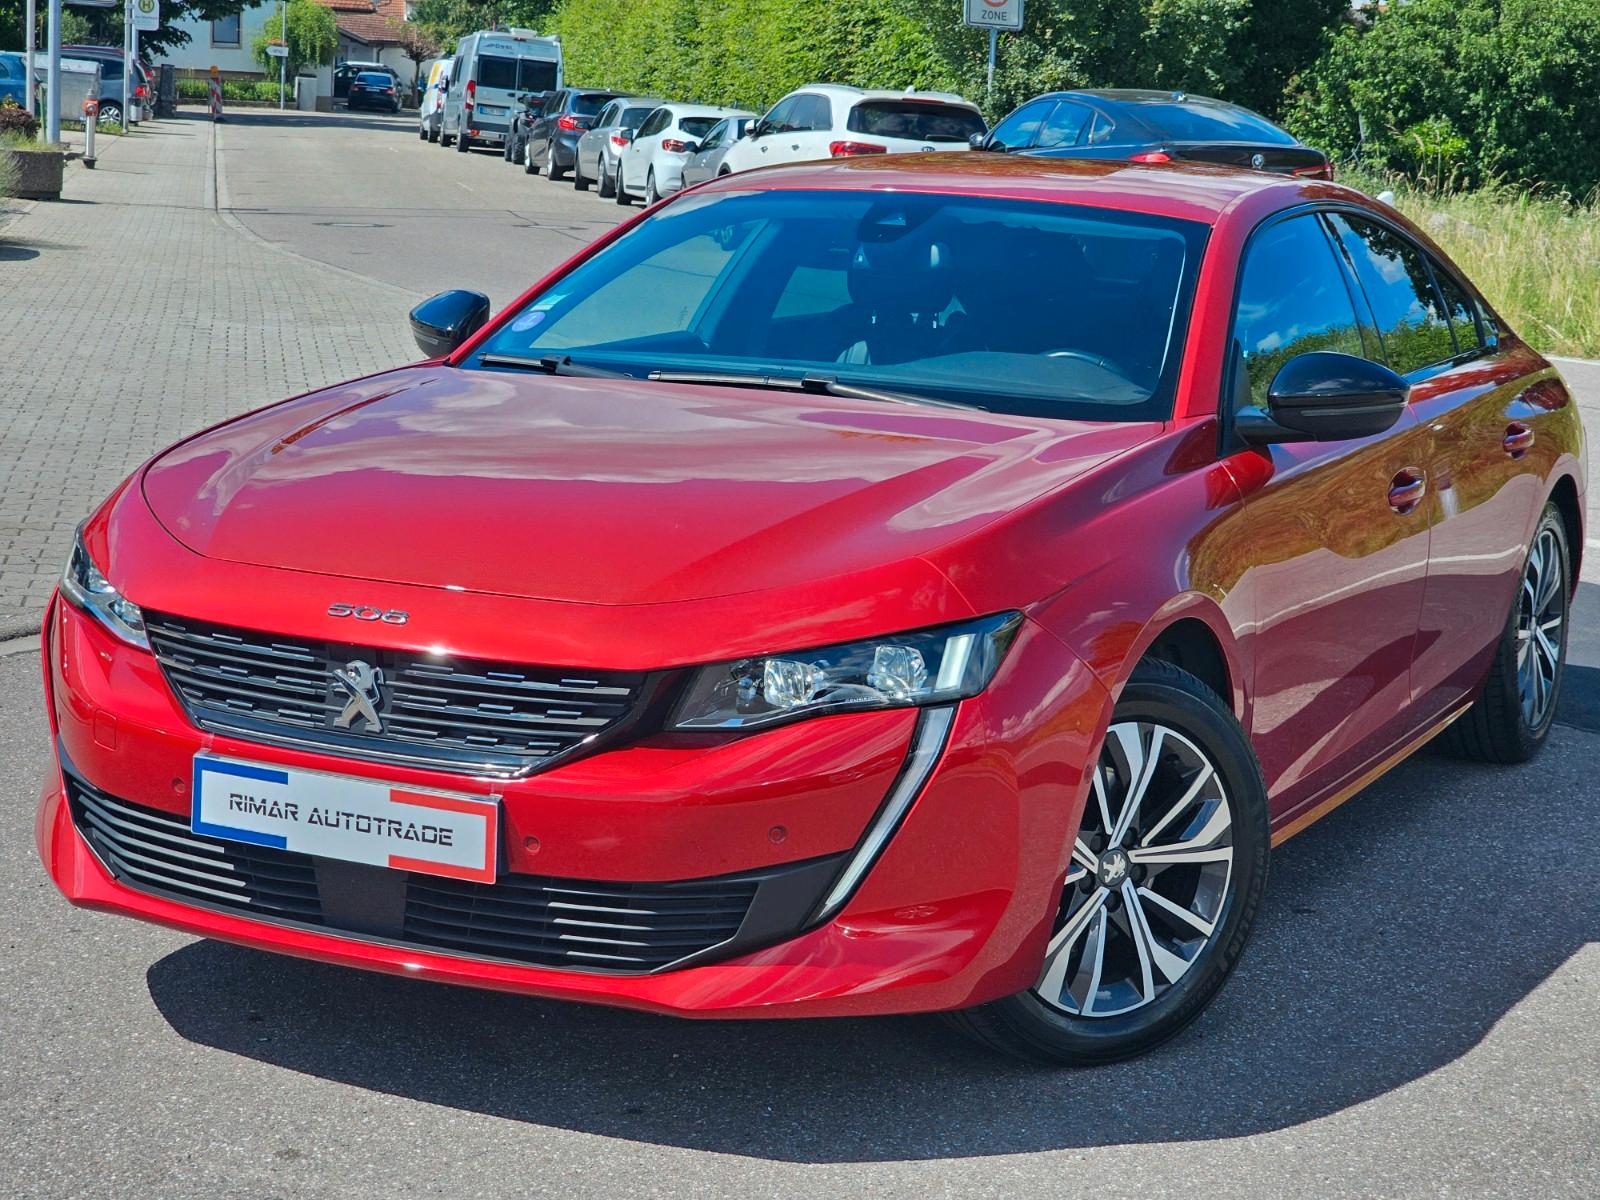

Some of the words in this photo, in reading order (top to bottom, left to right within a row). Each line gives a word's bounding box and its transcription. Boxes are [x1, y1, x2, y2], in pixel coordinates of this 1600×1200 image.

[142, 0, 151, 9] H
[981, 9, 1007, 21] ZONE
[327, 602, 409, 625] 508
[229, 793, 299, 822] RIMAR
[307, 807, 453, 847] AUTOTRADE
